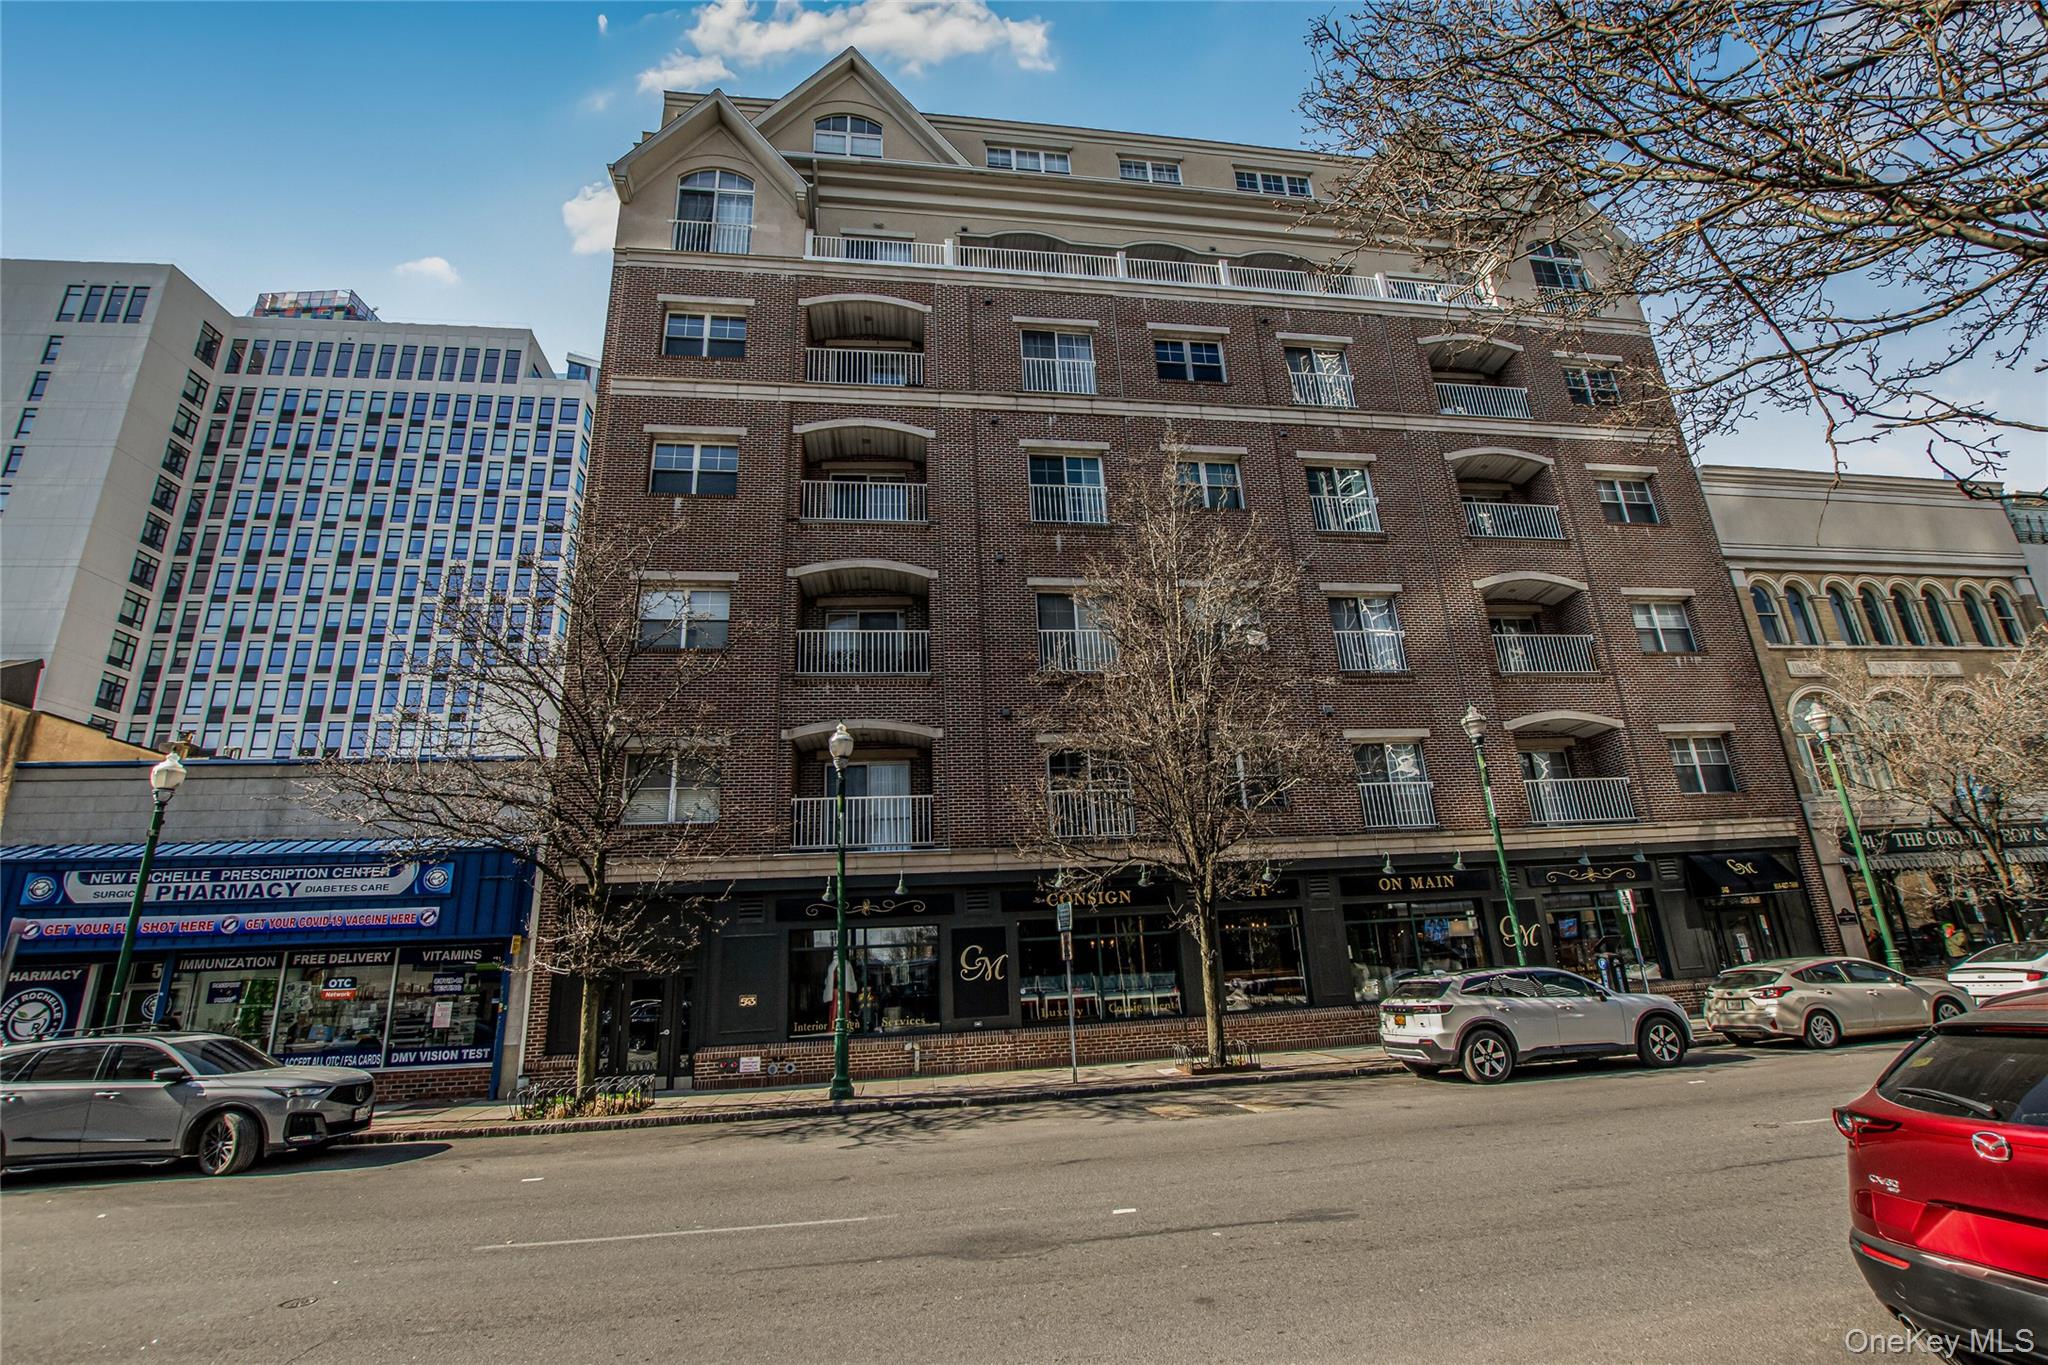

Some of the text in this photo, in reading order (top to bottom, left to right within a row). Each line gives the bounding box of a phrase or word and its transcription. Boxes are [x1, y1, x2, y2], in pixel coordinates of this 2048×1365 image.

[1892, 833, 1925, 847] THE
[90, 873, 126, 884] NEW
[220, 867, 328, 881] PRESCRIPTION
[332, 866, 390, 878] CENTER
[156, 881, 302, 900] PHARMACY
[305, 883, 390, 893] DIABETES CARE
[1378, 875, 1454, 891] ON MAIN
[92, 889, 148, 899] SURGIC
[1046, 889, 1131, 906] CONSIGN
[44, 923, 71, 936] GET
[75, 922, 110, 935] YOUR
[141, 921, 176, 933] SHOT
[179, 920, 214, 932] HERE
[245, 913, 416, 930] GET YOUR COVID-19 VACCINE HERE
[179, 955, 277, 970] IMMUNIZATION
[293, 951, 391, 966] FREE DELIVERY
[422, 949, 482, 961] VITAMINS
[8, 969, 82, 982] HARMACY
[328, 978, 352, 989] OTC
[1, 992, 62, 1021] NEW ROCHELLE
[1041, 1007, 1083, 1019] Luxuy
[793, 1021, 828, 1033] Interior
[881, 1015, 926, 1027] Services
[285, 1057, 312, 1067] ACCEPT
[312, 1056, 324, 1067] ALL
[358, 1054, 381, 1066] CARDS
[391, 1048, 490, 1063] DMV VISION TEST
